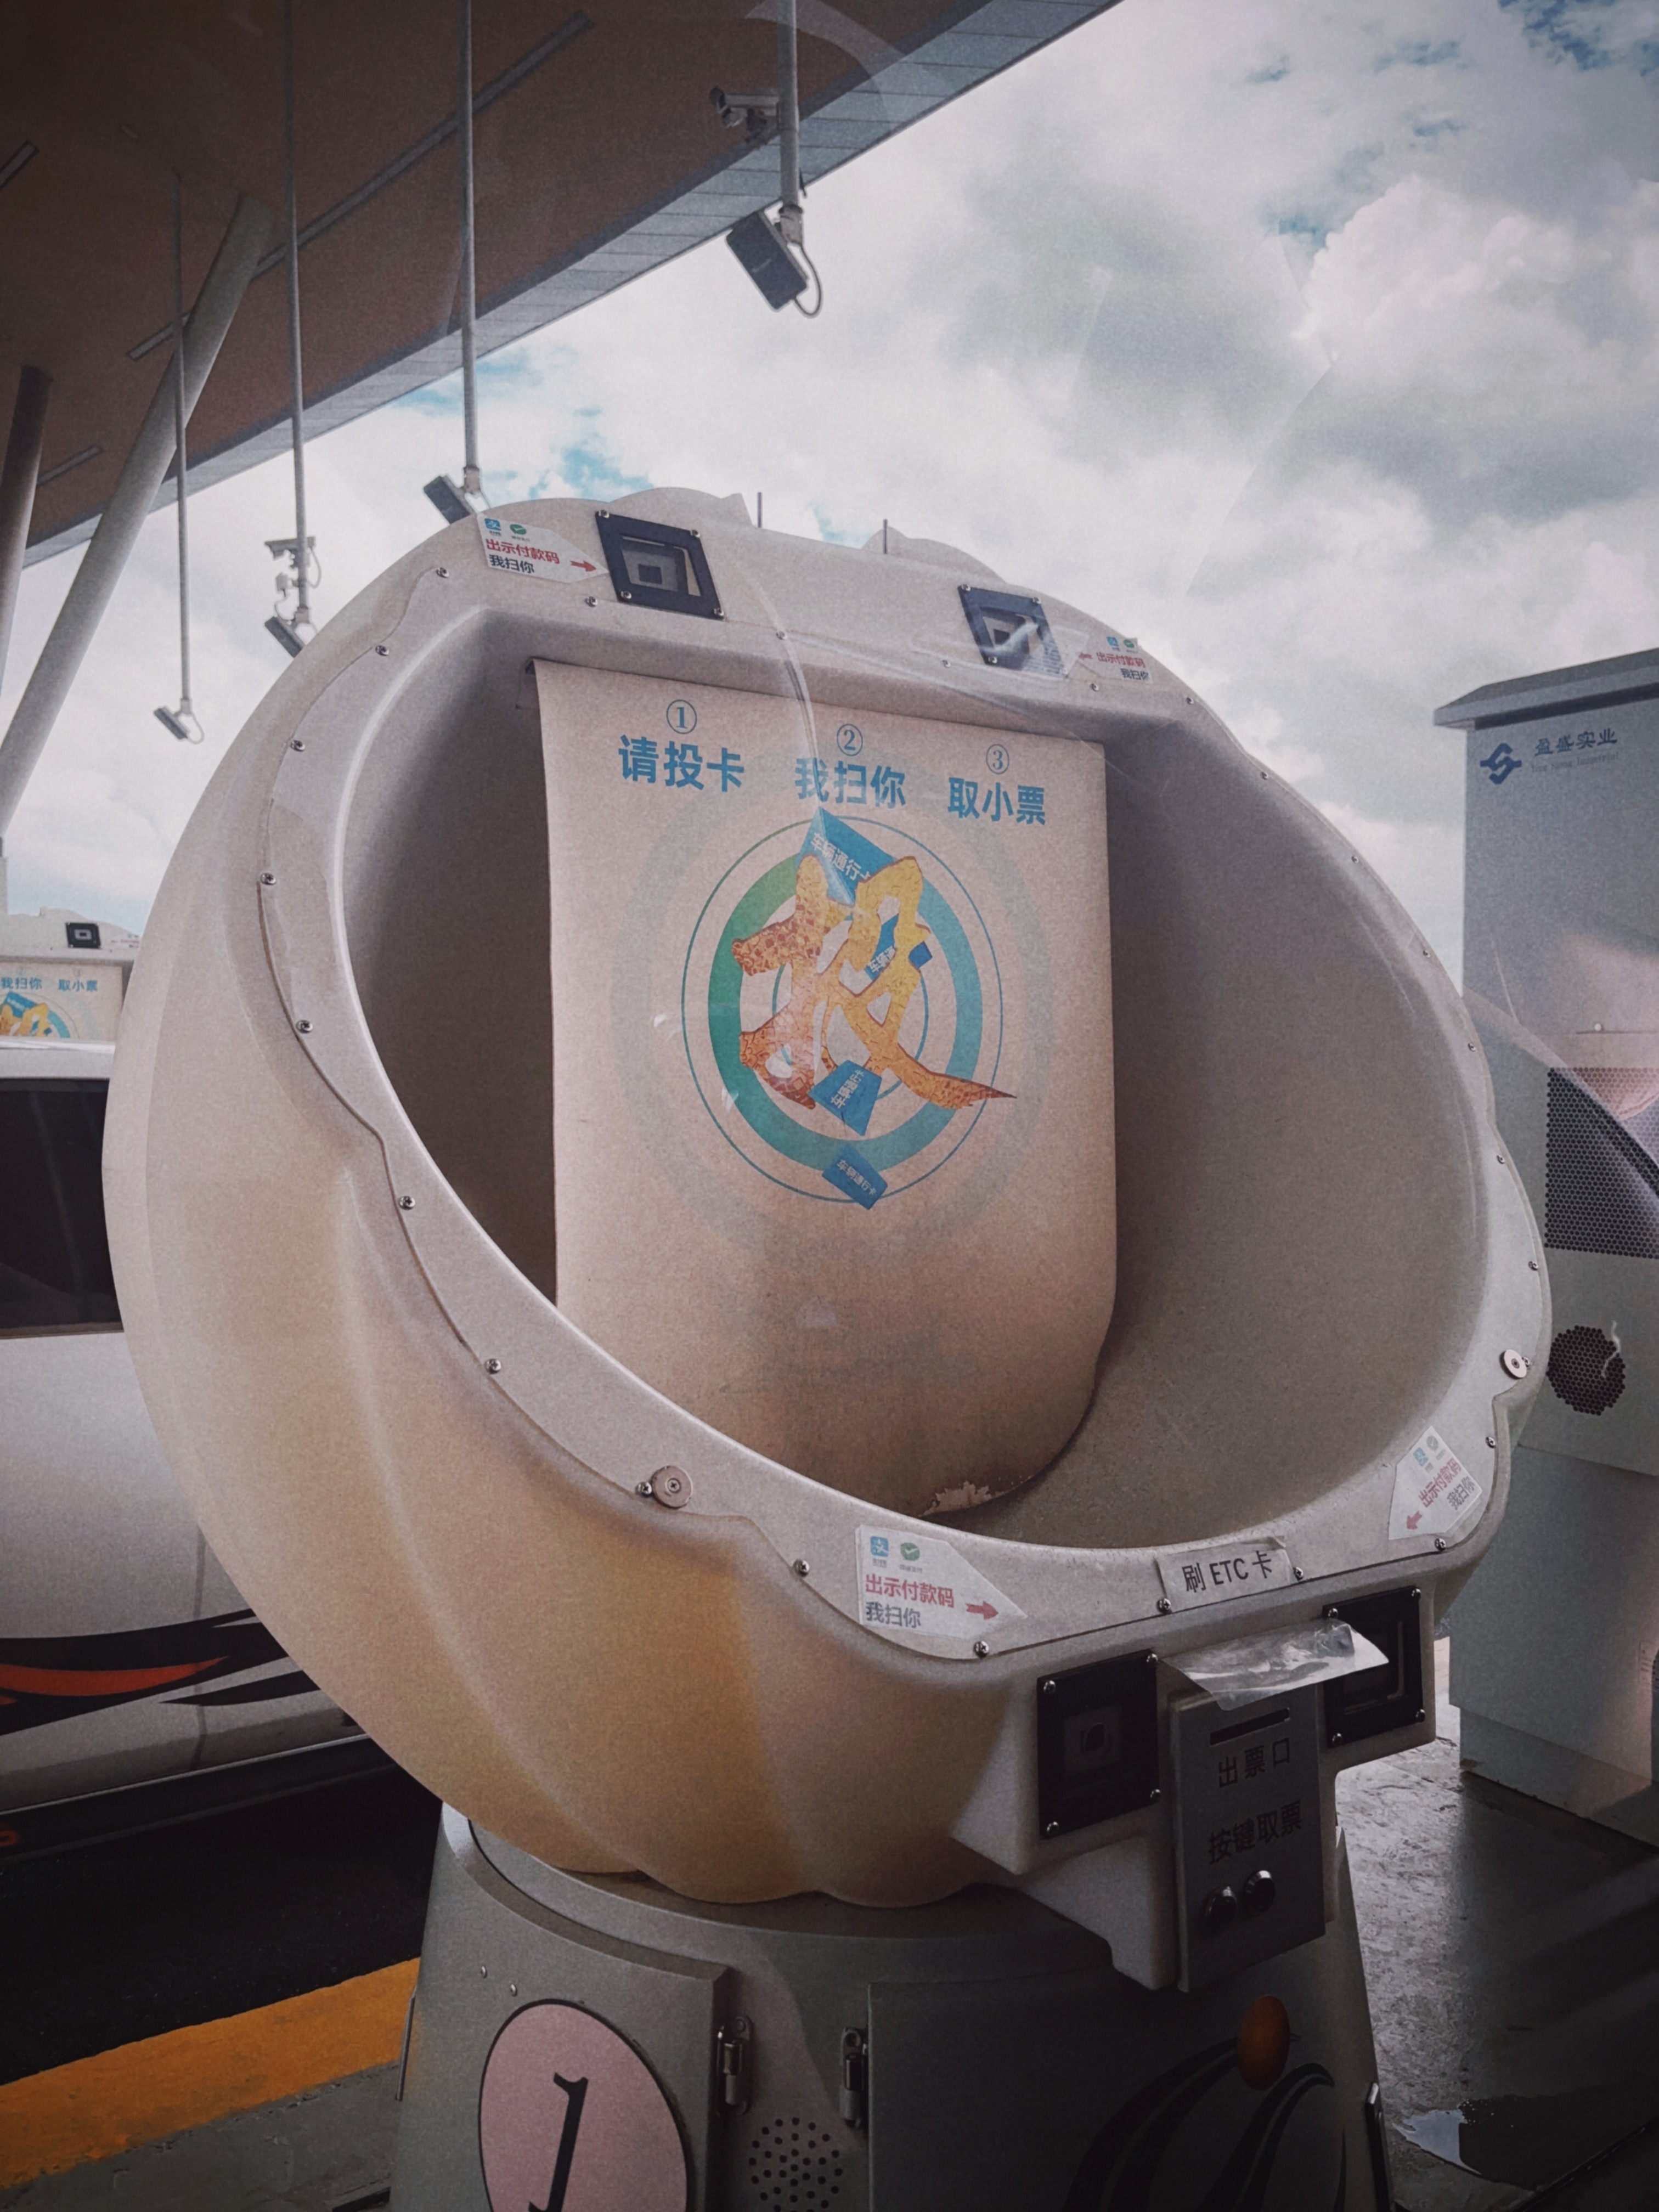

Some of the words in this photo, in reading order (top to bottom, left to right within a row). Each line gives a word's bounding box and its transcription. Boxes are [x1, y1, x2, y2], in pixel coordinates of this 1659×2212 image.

[486, 538, 560, 565] 出示付款码
[489, 554, 535, 573] 我扫你
[1096, 652, 1146, 668] 出示付款码
[1534, 727, 1618, 757] 盈盛实业
[618, 735, 745, 793] 请投卡
[794, 757, 906, 809] 我扫你
[947, 777, 1046, 826] 取小票
[1, 977, 42, 990] 我扫你
[58, 979, 98, 992] 取小票
[1418, 1457, 1462, 1508] 出示付款码
[1447, 1476, 1475, 1510] 我扫你
[865, 1573, 955, 1608] 出示付款码
[866, 1601, 921, 1628] 我扫你
[1218, 1737, 1290, 1788] 出票口
[1208, 1800, 1302, 1865] 按键取票
[528, 2071, 589, 2212] 1
